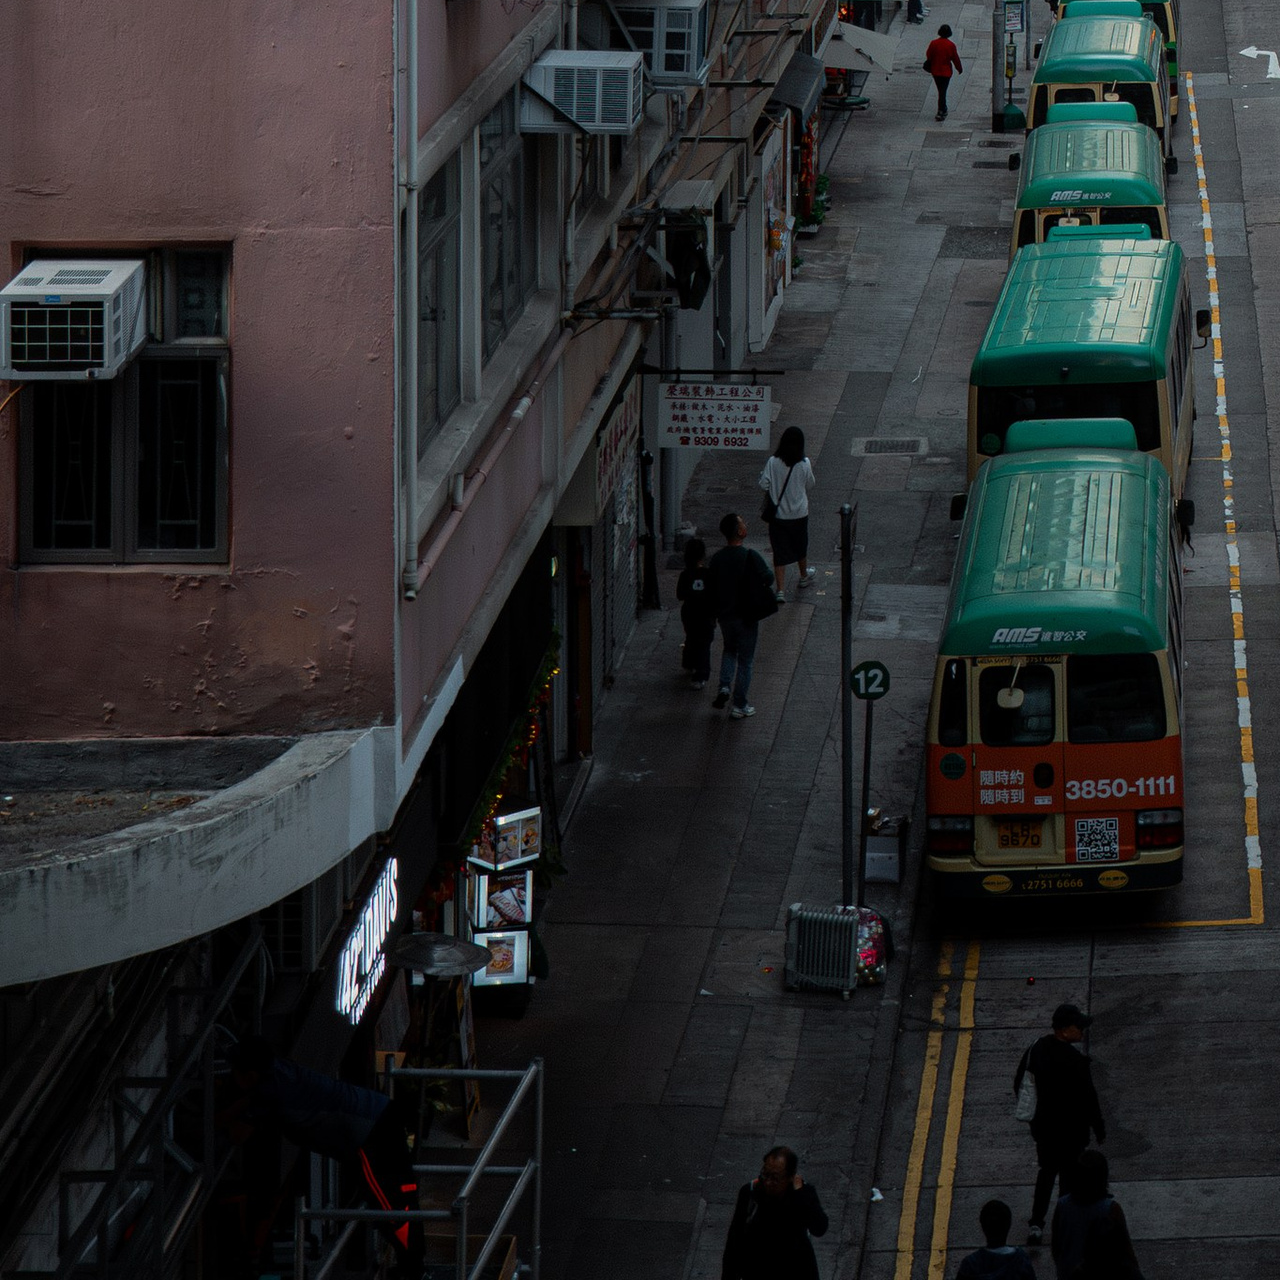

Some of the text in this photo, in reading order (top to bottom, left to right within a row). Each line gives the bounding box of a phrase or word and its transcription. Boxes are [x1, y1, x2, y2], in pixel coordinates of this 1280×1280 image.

[1050, 190, 1082, 201] AMS
[694, 436, 749, 447] 9309 6932
[991, 627, 1042, 643] AMS
[854, 668, 884, 694] 12
[979, 770, 1025, 786] 隨時約
[1065, 775, 1175, 800] 3850-1111
[980, 789, 1025, 805] 隨時到
[1028, 879, 1084, 889] 2751 6666
